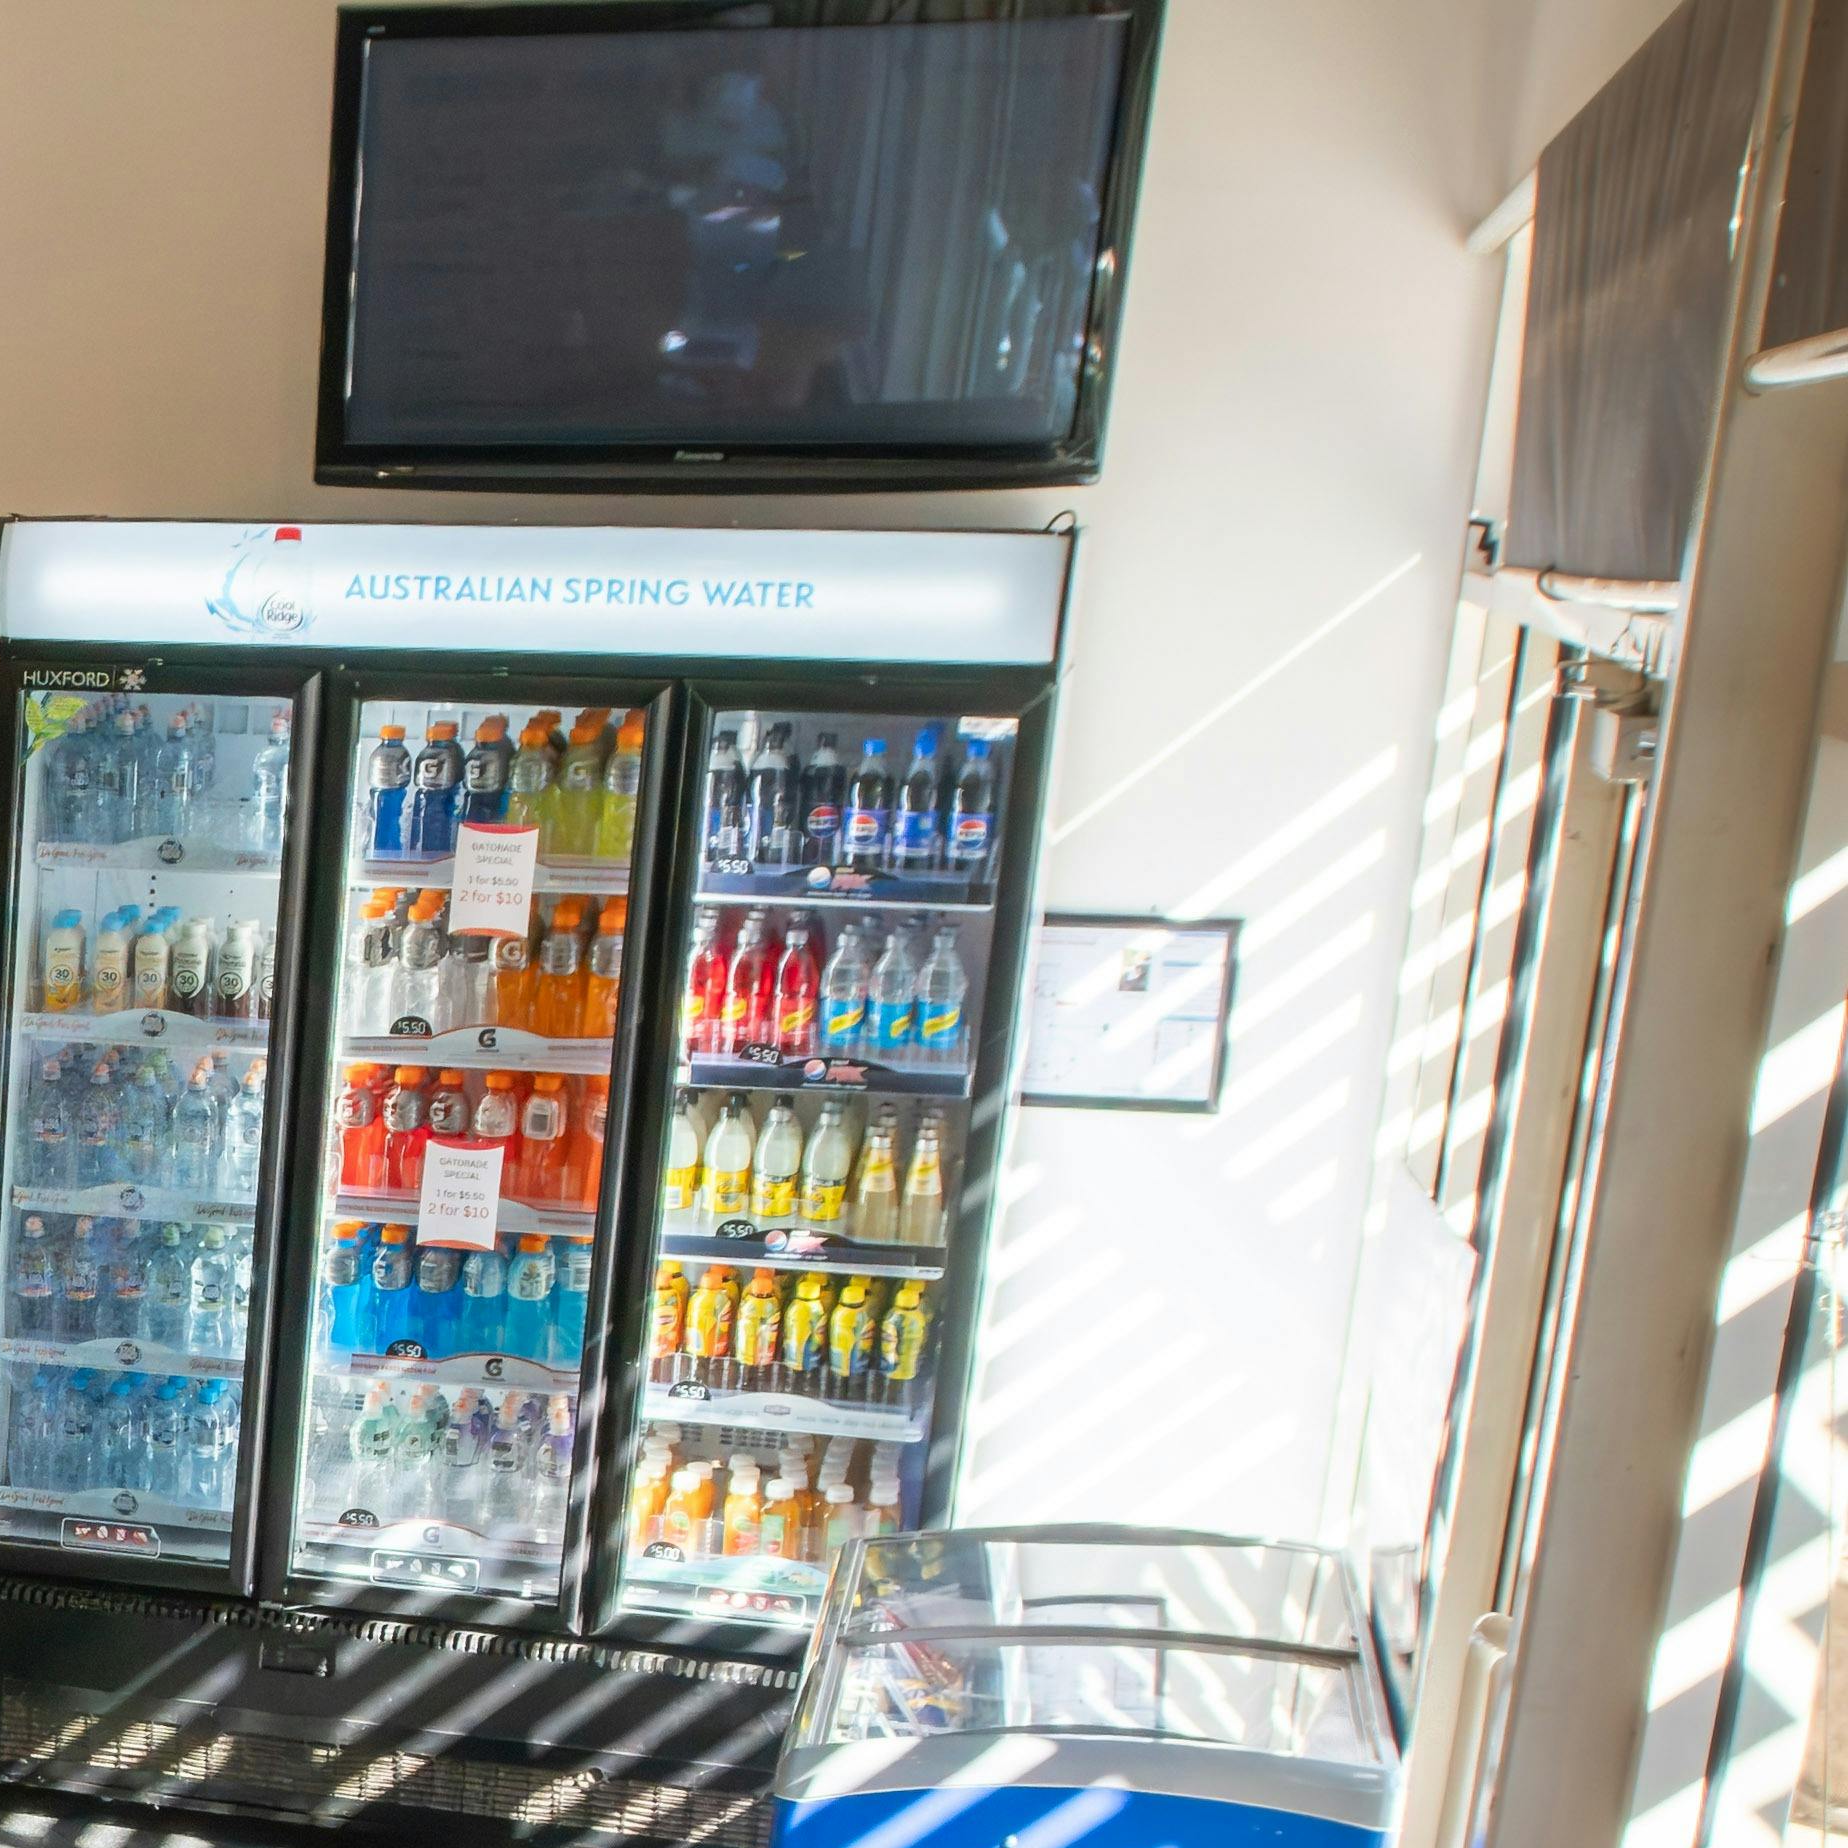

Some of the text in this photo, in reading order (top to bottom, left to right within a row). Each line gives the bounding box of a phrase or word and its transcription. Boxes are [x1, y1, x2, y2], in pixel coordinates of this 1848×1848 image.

[345, 572, 815, 610] AUSTRALIAN SPRING WATER
[267, 608, 299, 622] Ridge
[23, 670, 110, 687] HUXFORD
[459, 888, 523, 906] 2 for $10
[442, 1188, 457, 1200] for
[427, 1202, 490, 1220] 2 for $10
